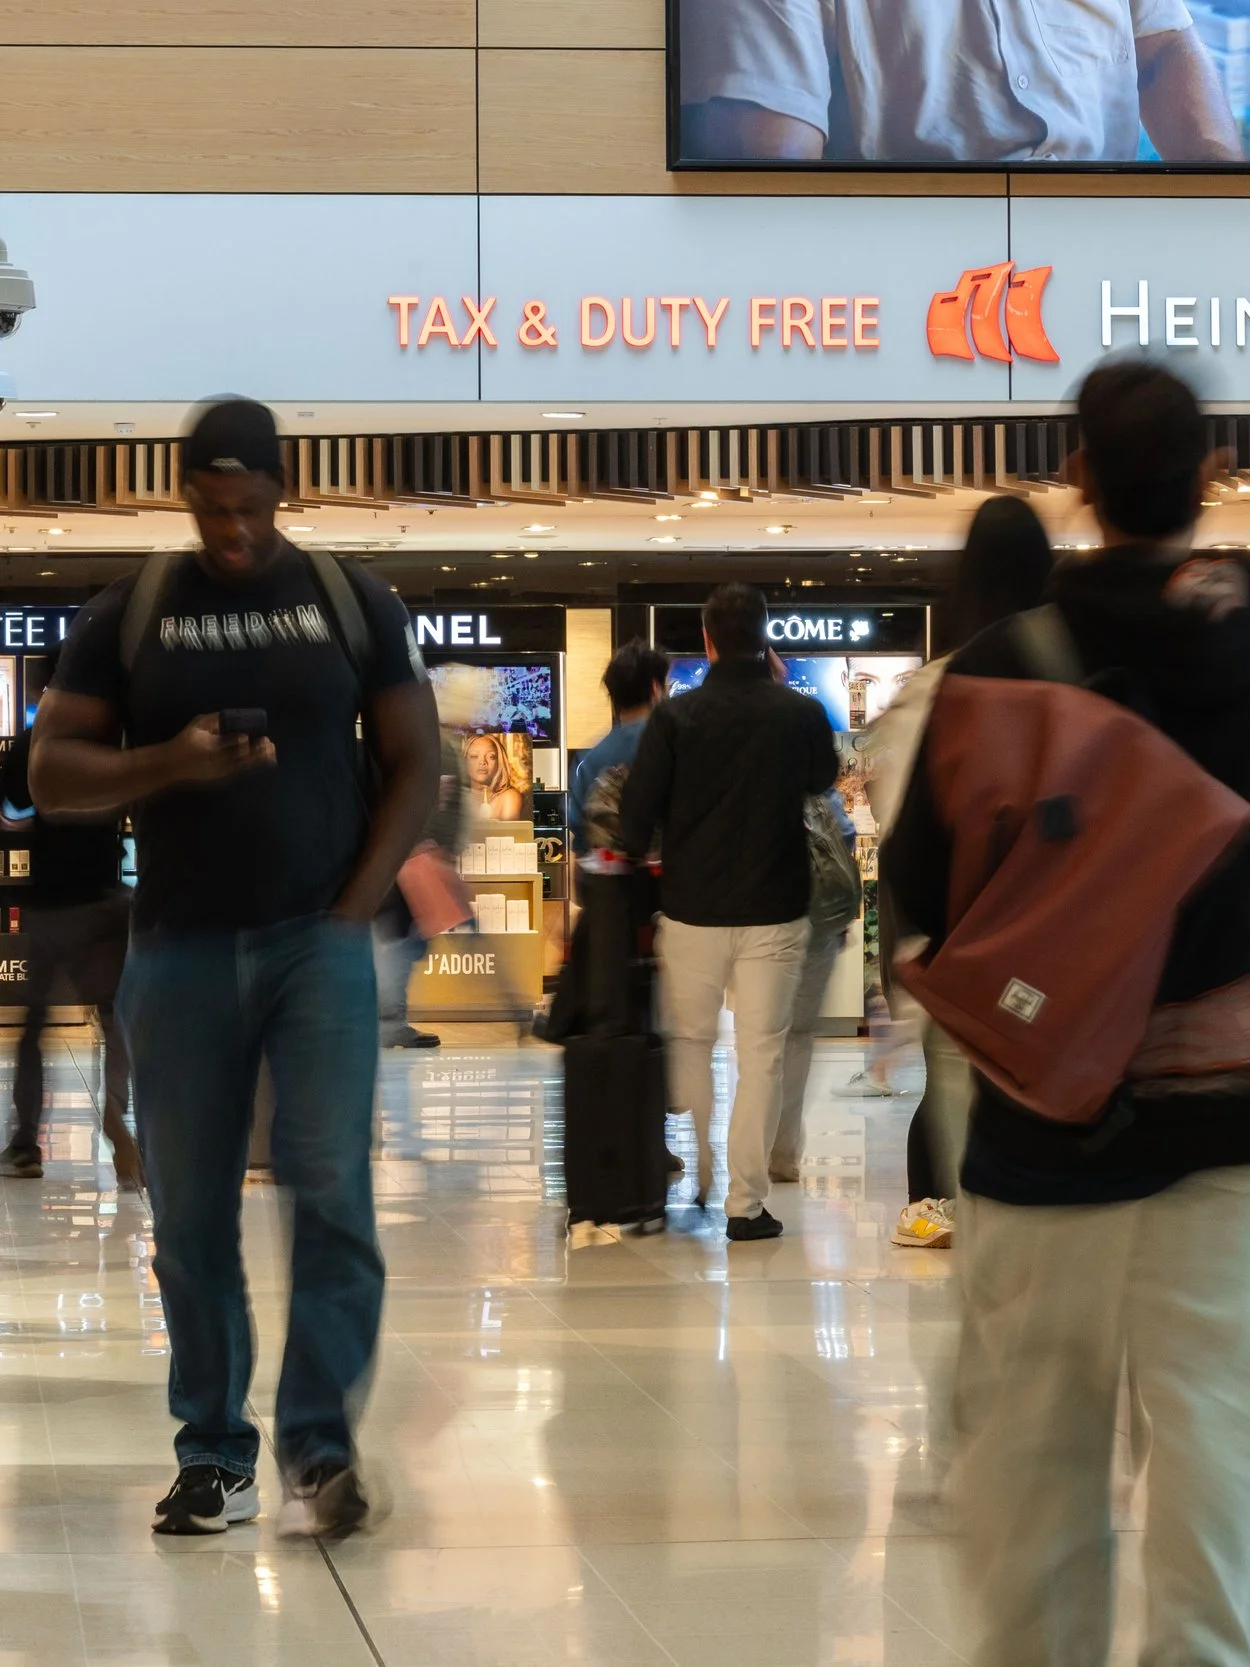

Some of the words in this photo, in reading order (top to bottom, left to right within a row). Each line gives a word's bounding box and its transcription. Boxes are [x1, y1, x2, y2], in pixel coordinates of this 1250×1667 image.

[388, 296, 498, 348] TAX
[517, 300, 558, 348] &
[580, 296, 731, 348] DUTY
[749, 296, 881, 348] FREE
[416, 615, 501, 645] NEL
[766, 615, 843, 641] CÔME
[424, 954, 496, 975] J'ADORE
